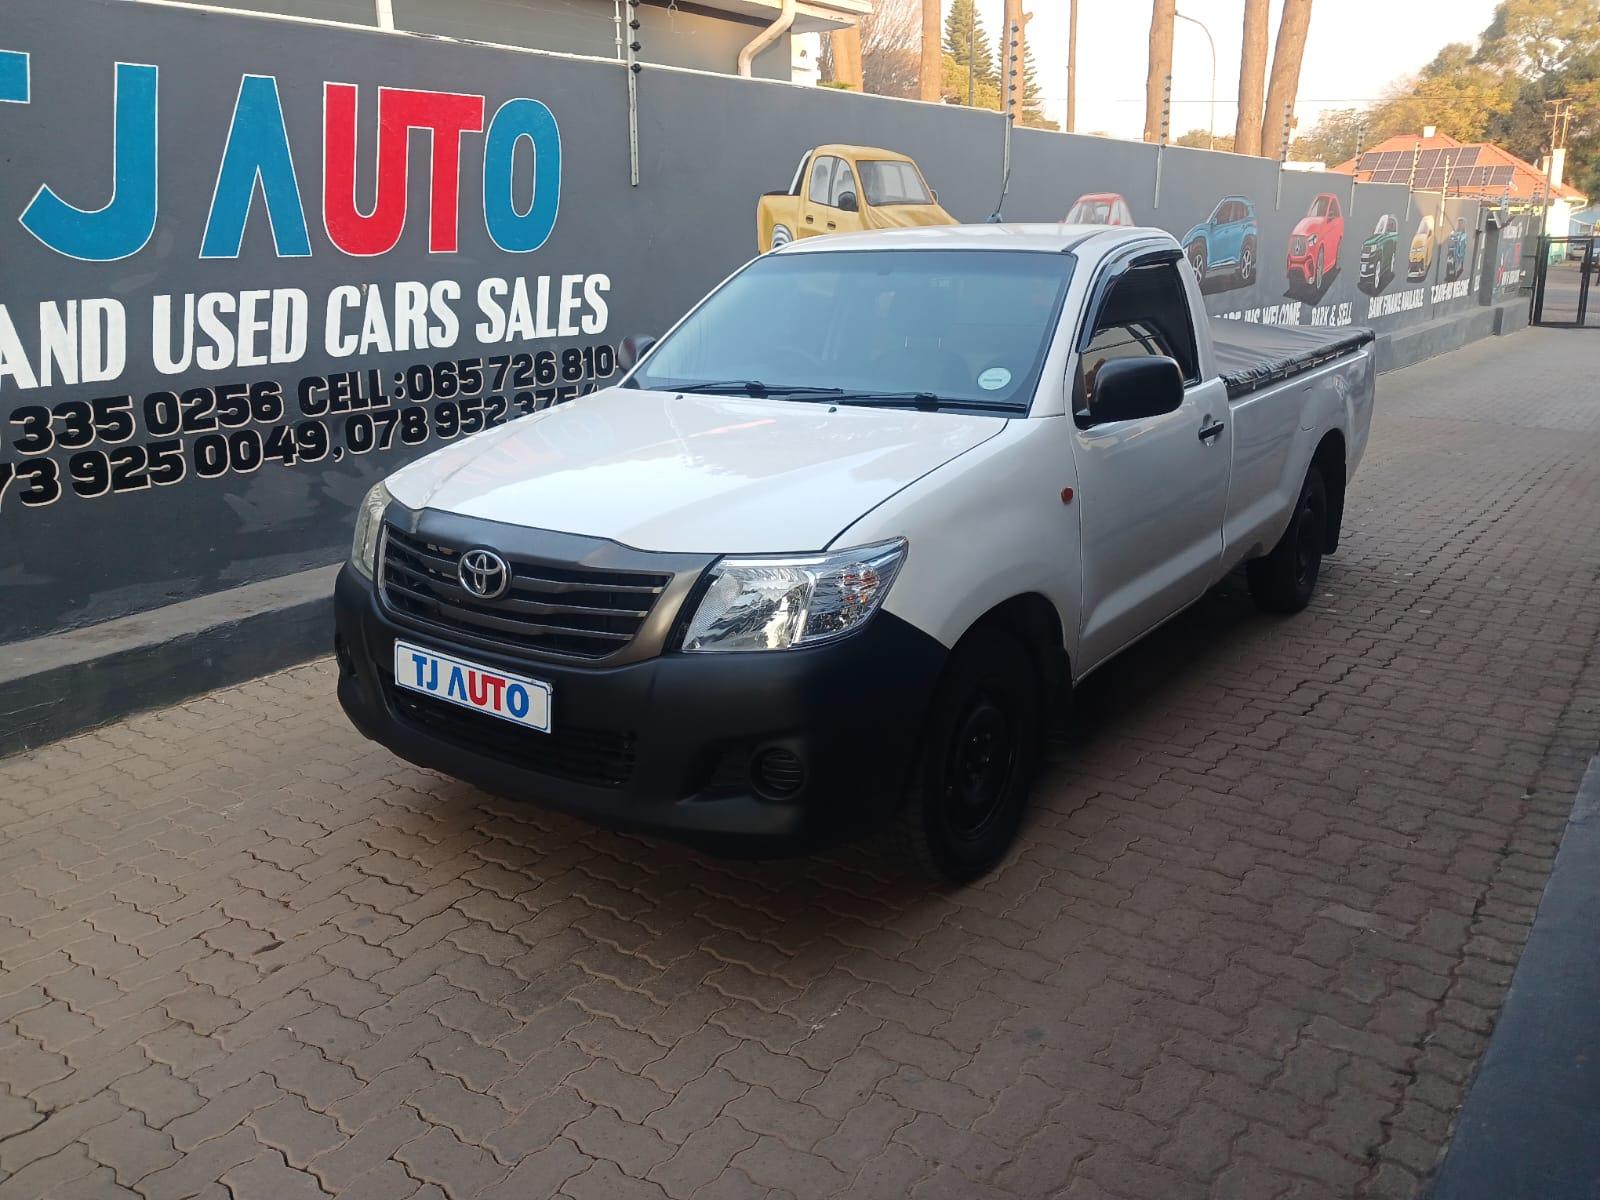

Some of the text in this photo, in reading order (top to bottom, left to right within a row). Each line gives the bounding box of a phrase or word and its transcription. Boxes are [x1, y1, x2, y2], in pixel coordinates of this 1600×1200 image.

[199, 73, 562, 258] AUTO
[152, 288, 308, 375] USED
[325, 280, 461, 358] CARS
[475, 273, 611, 344] SALES
[1329, 304, 1337, 327] &
[1337, 301, 1352, 327] SELL
[9, 394, 137, 456] 335
[143, 380, 285, 438] 0256
[489, 350, 558, 393] 726
[562, 344, 619, 383] 810
[69, 438, 187, 499] 925
[434, 394, 508, 440] 952
[412, 653, 530, 718] TJ AUTO
